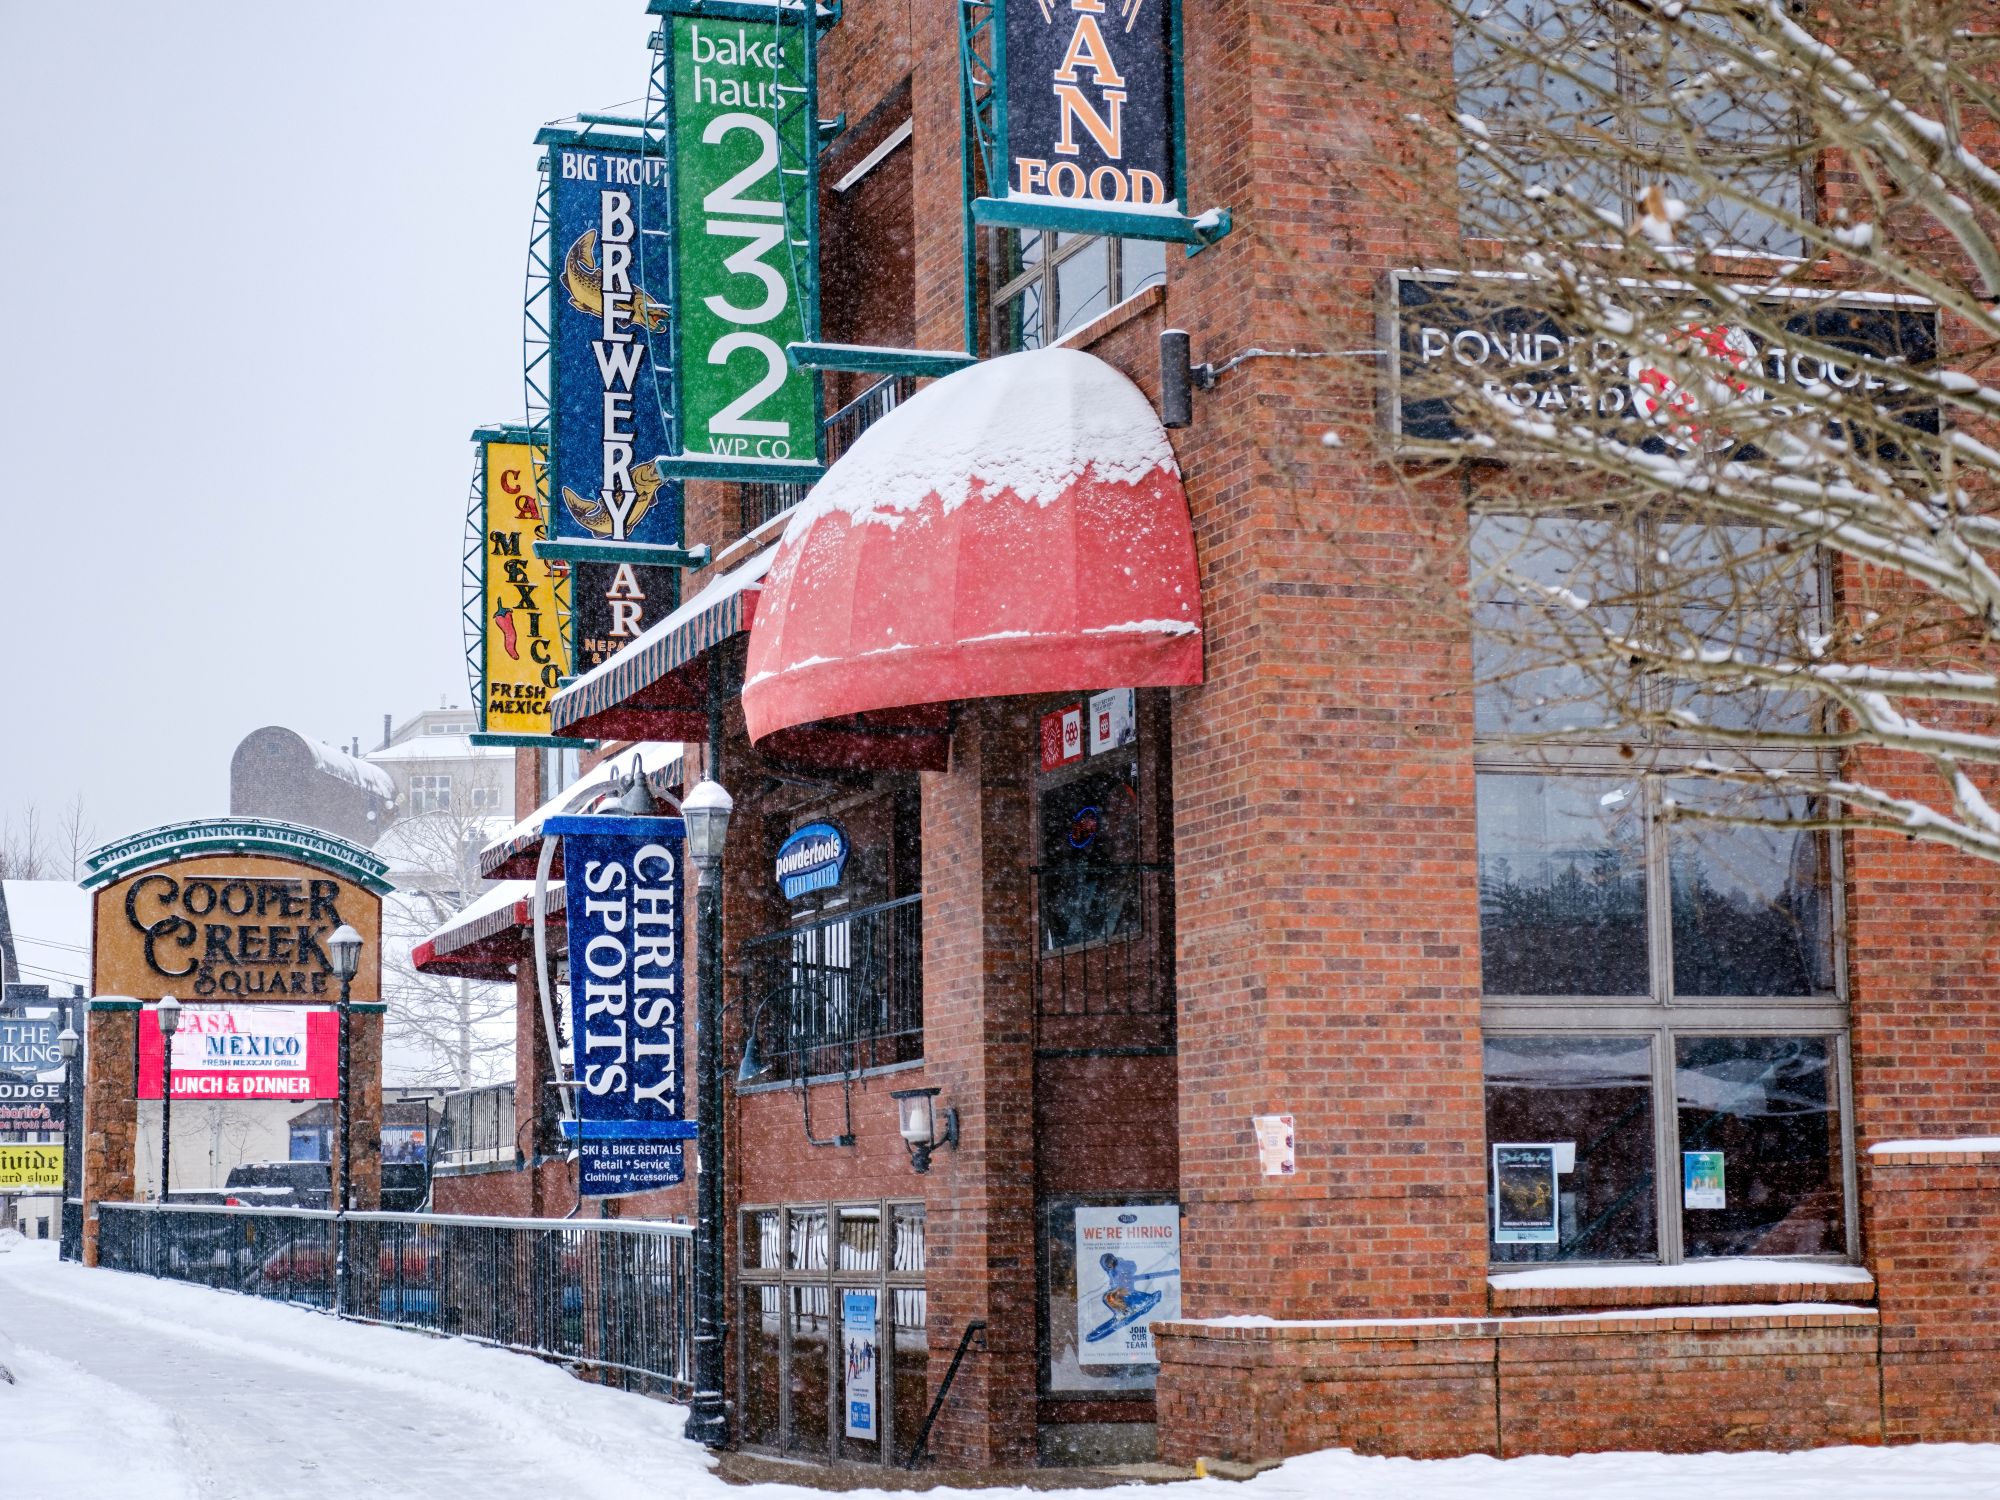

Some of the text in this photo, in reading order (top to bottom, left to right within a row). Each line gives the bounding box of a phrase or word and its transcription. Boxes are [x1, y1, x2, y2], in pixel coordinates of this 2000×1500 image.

[691, 25, 786, 70] bake
[694, 65, 786, 111] haus
[1053, 0, 1127, 160] AN
[562, 152, 598, 182] BIG
[1015, 157, 1165, 205] FOOD
[701, 112, 790, 438] 232
[591, 189, 646, 541] BREWERY
[709, 437, 790, 460] WP CO
[490, 530, 564, 688] MEXICO
[490, 682, 546, 699] FRESH
[489, 700, 552, 715] MEXICA
[97, 826, 382, 873] SHOPPING DINING ENTERTAINMENT
[775, 832, 840, 882] powdertools
[125, 874, 347, 934] COOPER
[144, 914, 335, 977] CREEK
[194, 965, 329, 995] SQUARE
[585, 861, 628, 1096] SPORTS
[633, 844, 676, 1114] CHRISTY
[3, 1026, 50, 1045] THE
[206, 1035, 301, 1056] MEXICO
[0, 1045, 62, 1063] IKING
[274, 1059, 299, 1067] GRILL
[171, 1076, 310, 1094] UNCH & DINNER
[581, 1145, 682, 1156] SKI & BIKE RENTALS
[593, 1159, 670, 1170] Retail Service
[28, 1171, 59, 1185] shop
[584, 1172, 679, 1184] Clothing Accessories
[1083, 1225, 1173, 1240] WE'RE HIRING
[1129, 1326, 1147, 1334] JOIN
[1131, 1333, 1147, 1341] OUR
[1125, 1341, 1148, 1349] TEAM
